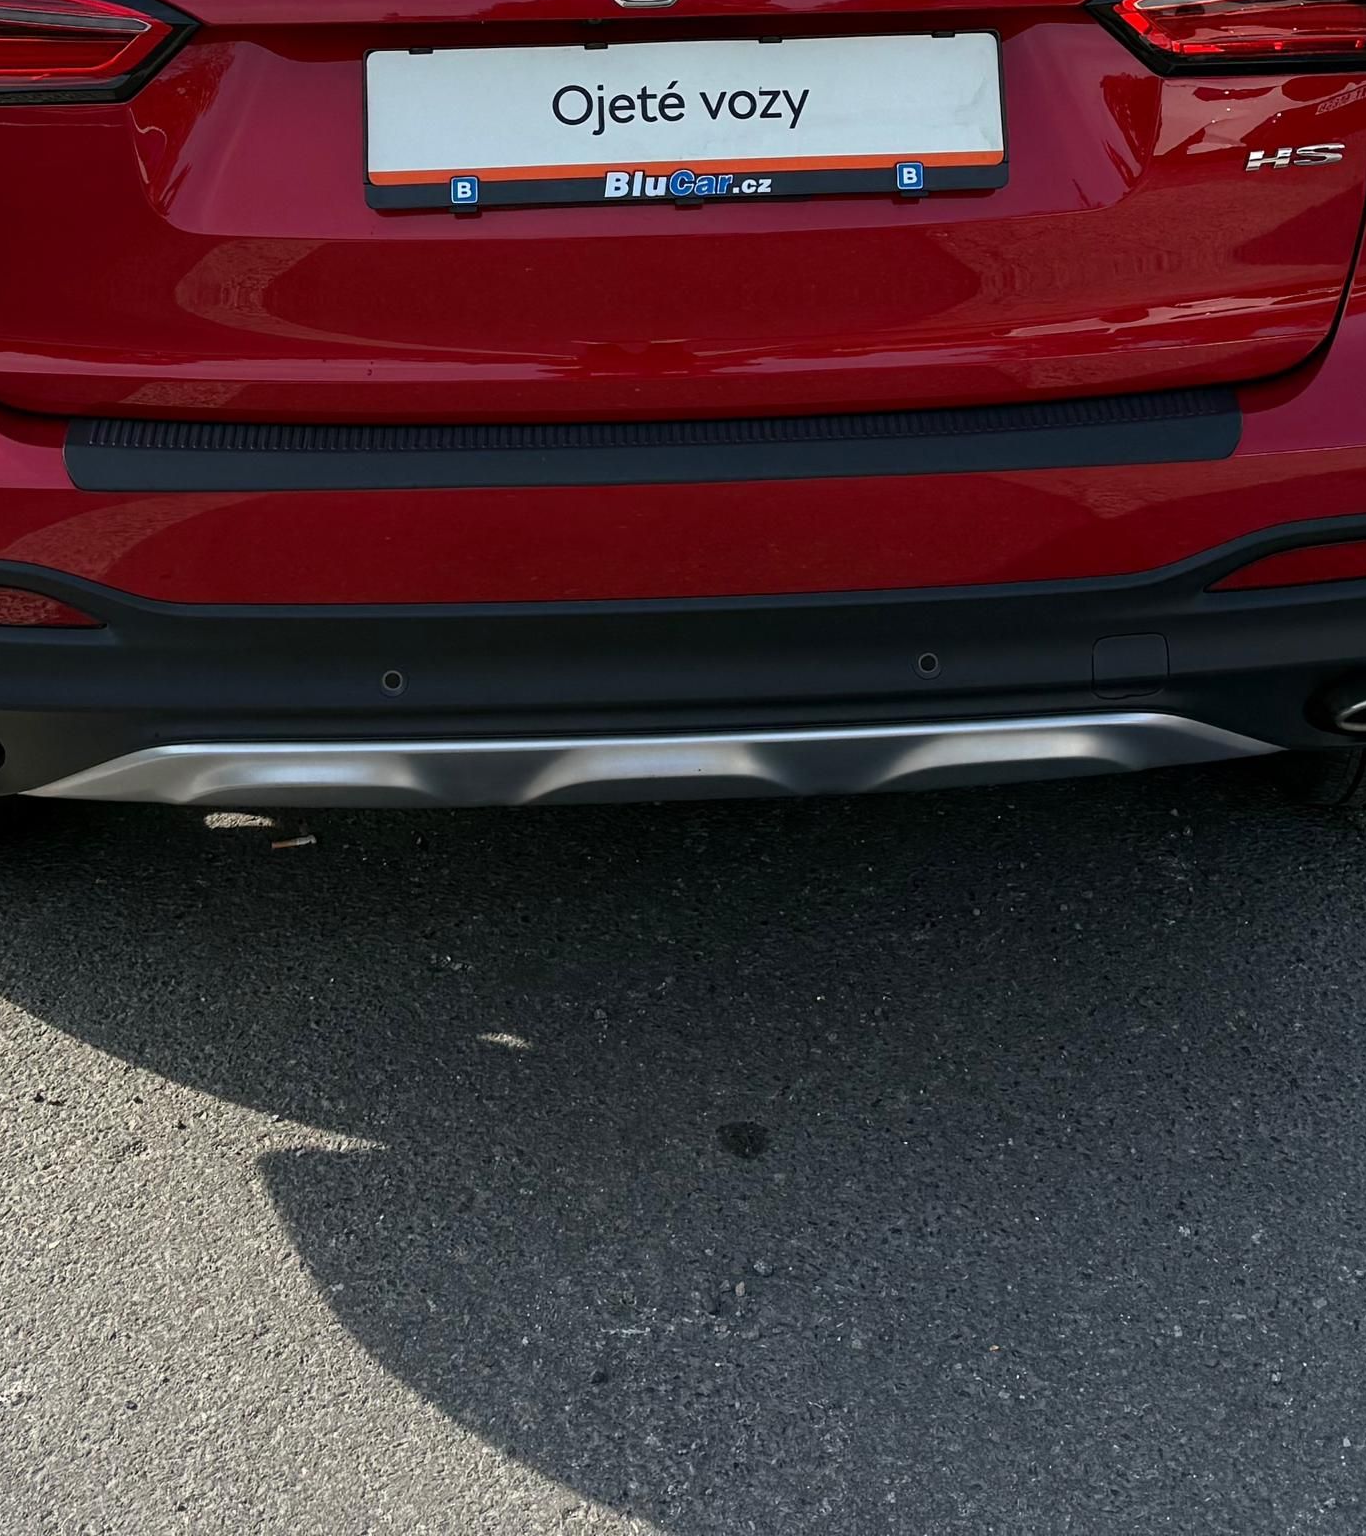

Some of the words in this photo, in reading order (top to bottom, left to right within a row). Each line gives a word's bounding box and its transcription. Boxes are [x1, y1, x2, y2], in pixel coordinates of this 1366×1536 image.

[552, 80, 685, 135] Ojeté
[699, 89, 810, 129] vozy
[1245, 142, 1346, 172] HS
[457, 181, 472, 198] B
[604, 169, 773, 198] BluCar.cz
[903, 167, 917, 184] B
